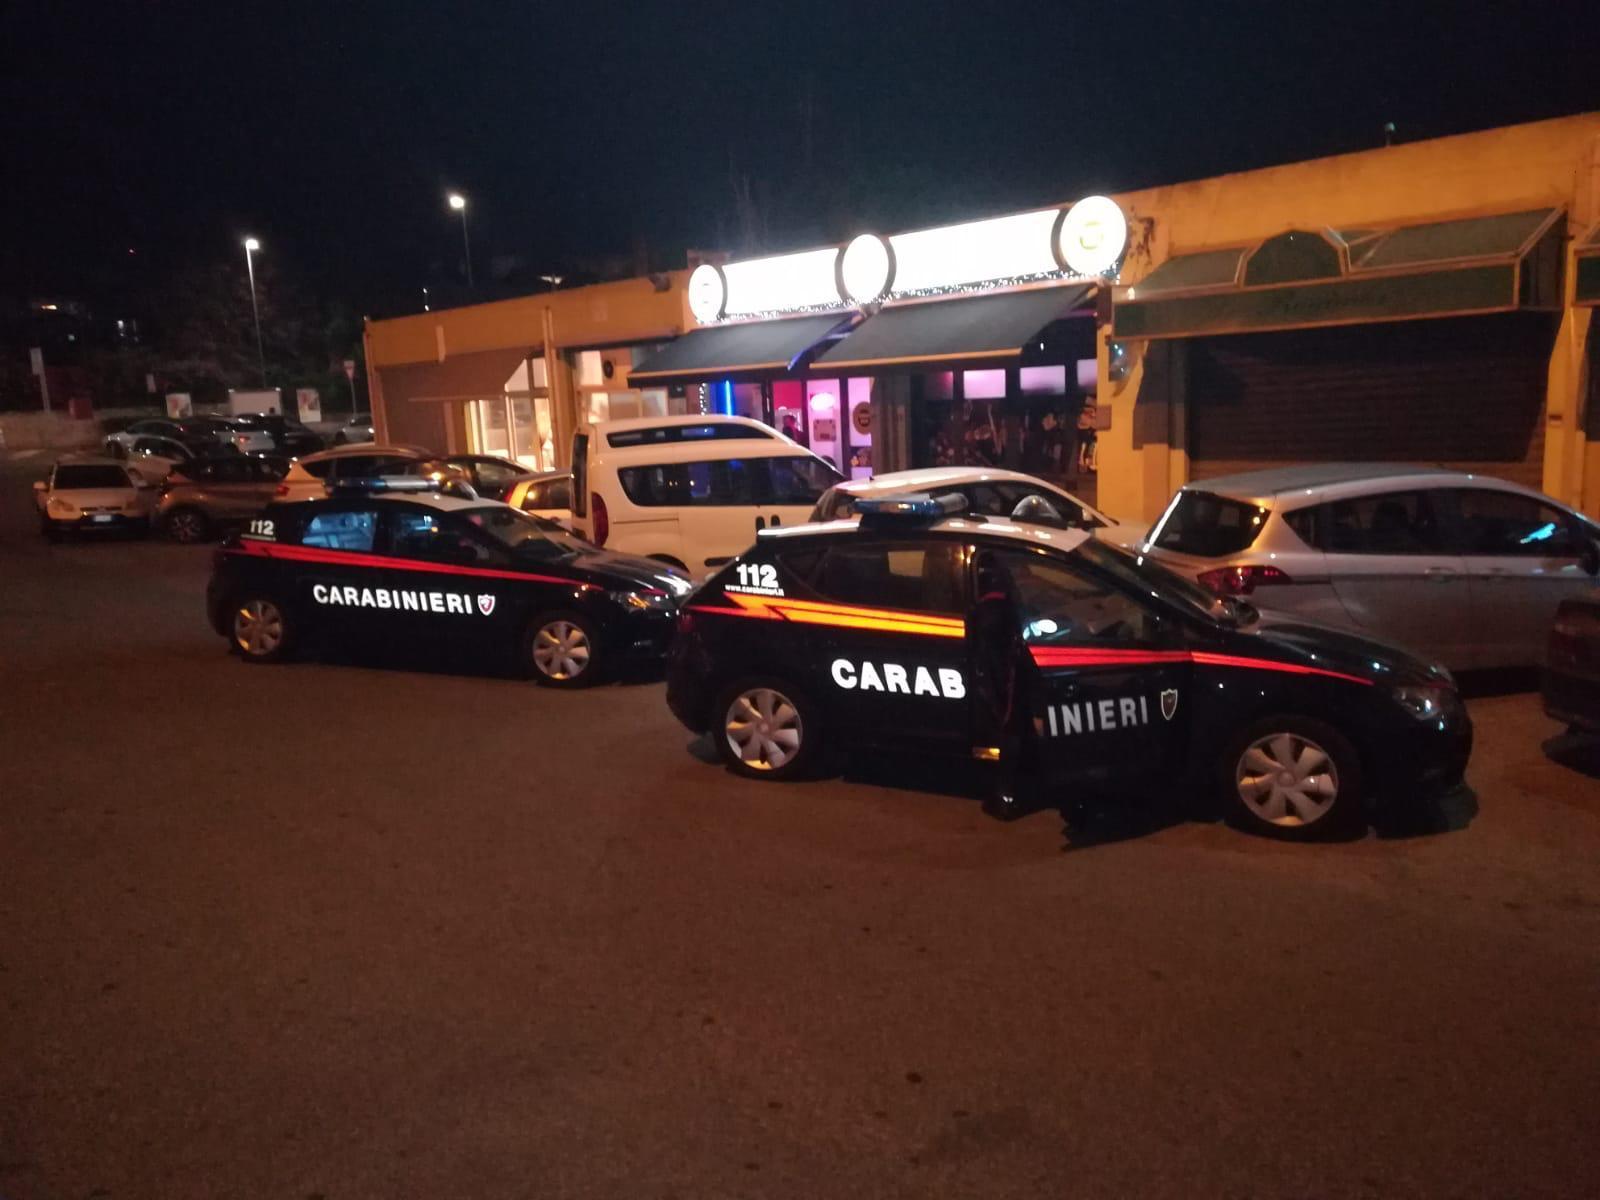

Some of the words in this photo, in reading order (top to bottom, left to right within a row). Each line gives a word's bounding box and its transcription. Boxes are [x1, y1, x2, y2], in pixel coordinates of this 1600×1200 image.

[250, 519, 275, 535] 112
[736, 563, 779, 588] 112
[313, 584, 473, 615] CARABINIERI
[831, 659, 966, 699] CARAB
[1048, 697, 1149, 737] INIERI
